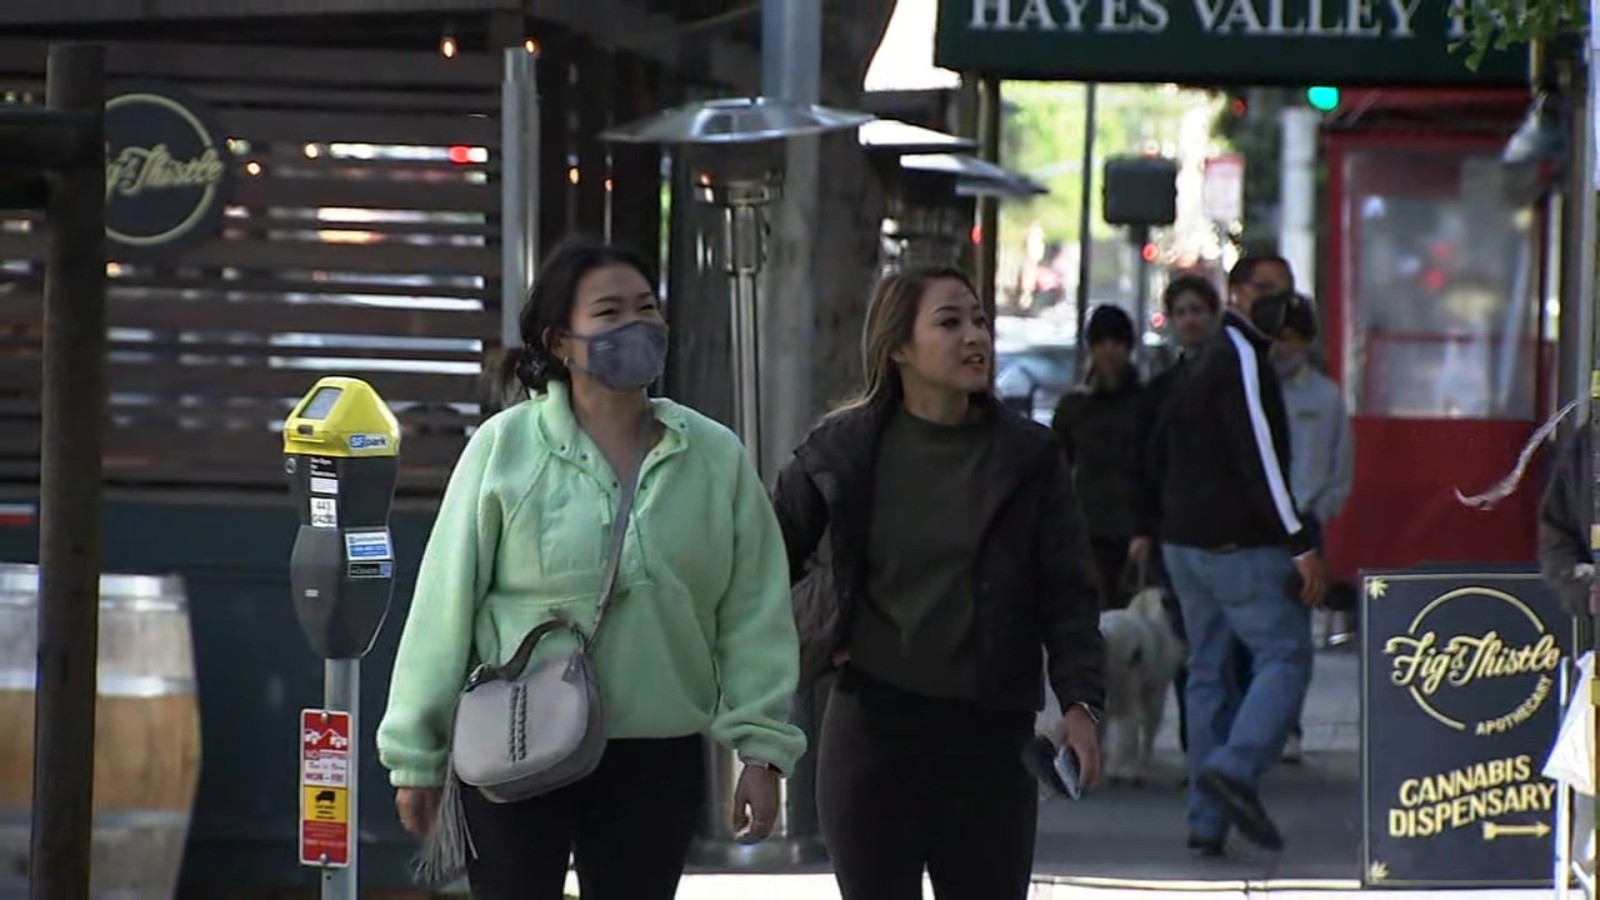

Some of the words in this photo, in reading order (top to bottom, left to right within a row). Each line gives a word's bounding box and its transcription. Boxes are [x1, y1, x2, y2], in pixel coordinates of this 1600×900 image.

[969, 0, 1168, 33] HAYES
[1198, 0, 1418, 37] VALLEY
[1475, 674, 1553, 735] APOTHECARY
[1399, 754, 1532, 807] CANNABIS
[1388, 782, 1556, 838] DISPENSARY
